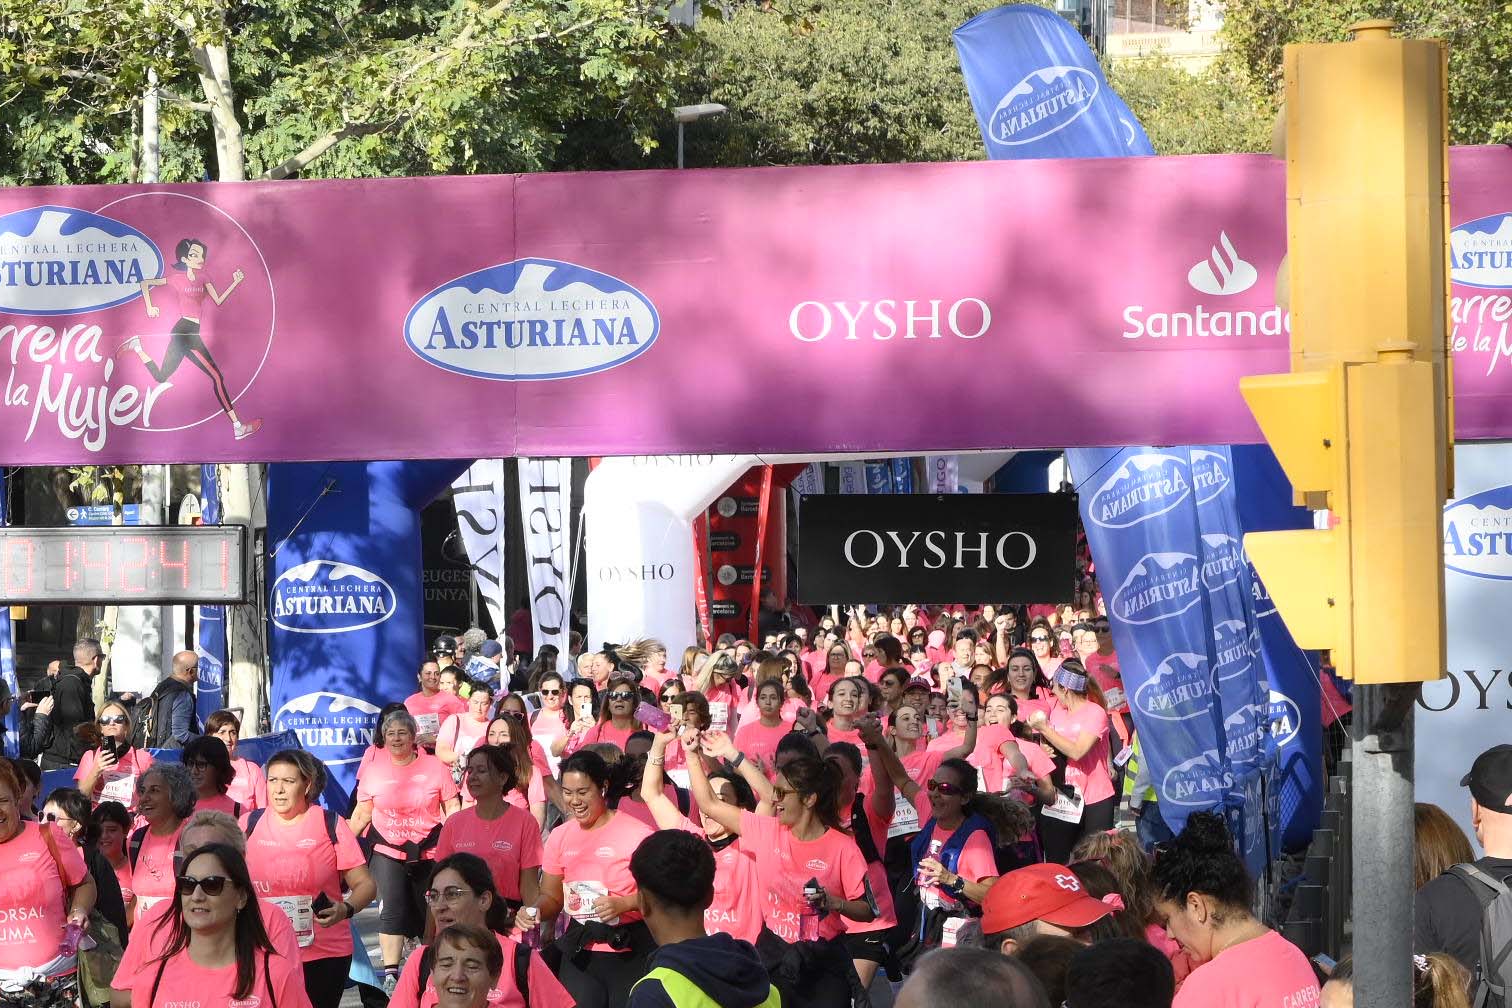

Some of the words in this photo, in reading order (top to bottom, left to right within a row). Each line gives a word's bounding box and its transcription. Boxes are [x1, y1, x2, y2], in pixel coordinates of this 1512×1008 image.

[67, 241, 139, 254] LECHERA
[464, 300, 541, 314] CENTRAL
[550, 299, 631, 312] LECHERA
[424, 306, 639, 350] ASTURIANA
[789, 298, 991, 341] OYSHO
[4, 367, 29, 406] la
[25, 358, 175, 452] Mujer
[844, 529, 1037, 570] OYSHO
[287, 585, 329, 594] CENTRAL
[334, 585, 382, 593] LECHERA
[275, 590, 386, 617] ASTURIANA
[288, 717, 329, 726] CENTRAL
[334, 716, 377, 725] LECHER
[255, 881, 270, 893] TU
